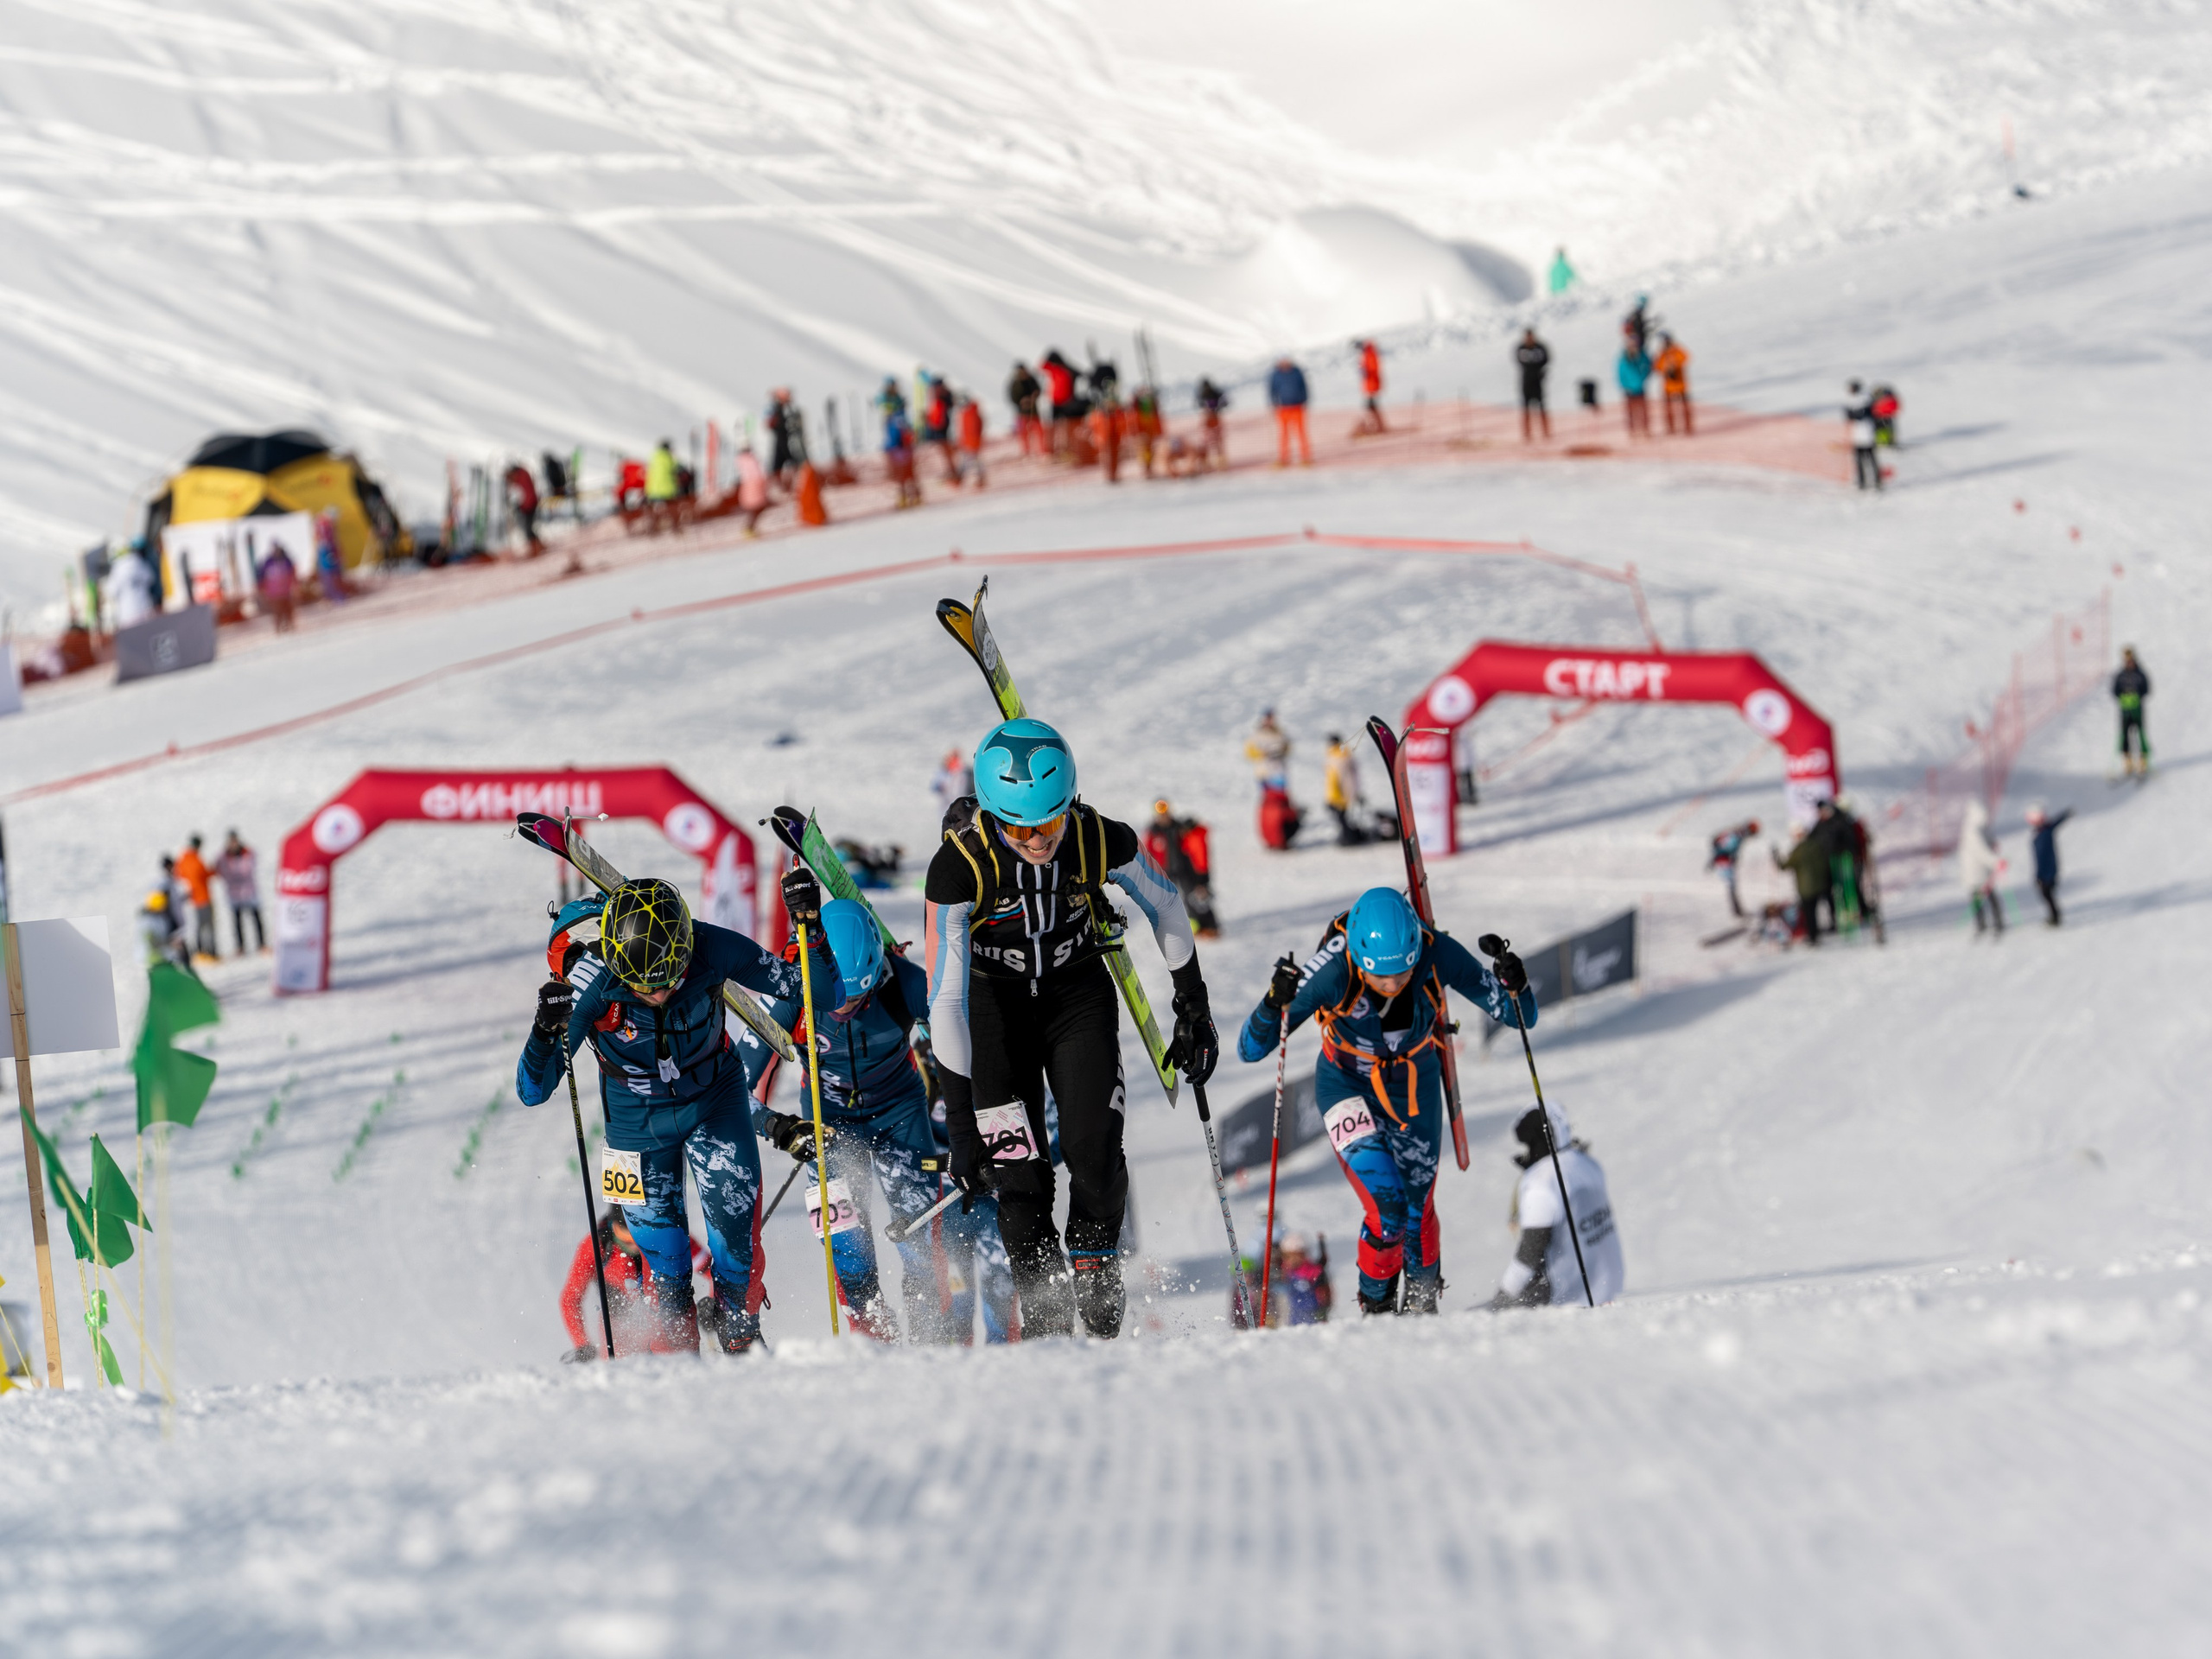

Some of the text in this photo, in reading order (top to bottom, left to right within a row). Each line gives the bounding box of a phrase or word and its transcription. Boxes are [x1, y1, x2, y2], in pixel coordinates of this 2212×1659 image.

[1545, 659, 1670, 699] СТАРТ
[422, 782, 604, 820] ФИНИШ
[1331, 1111, 1370, 1141] 704
[604, 1169, 641, 1195] 502
[810, 1198, 853, 1228] 703
